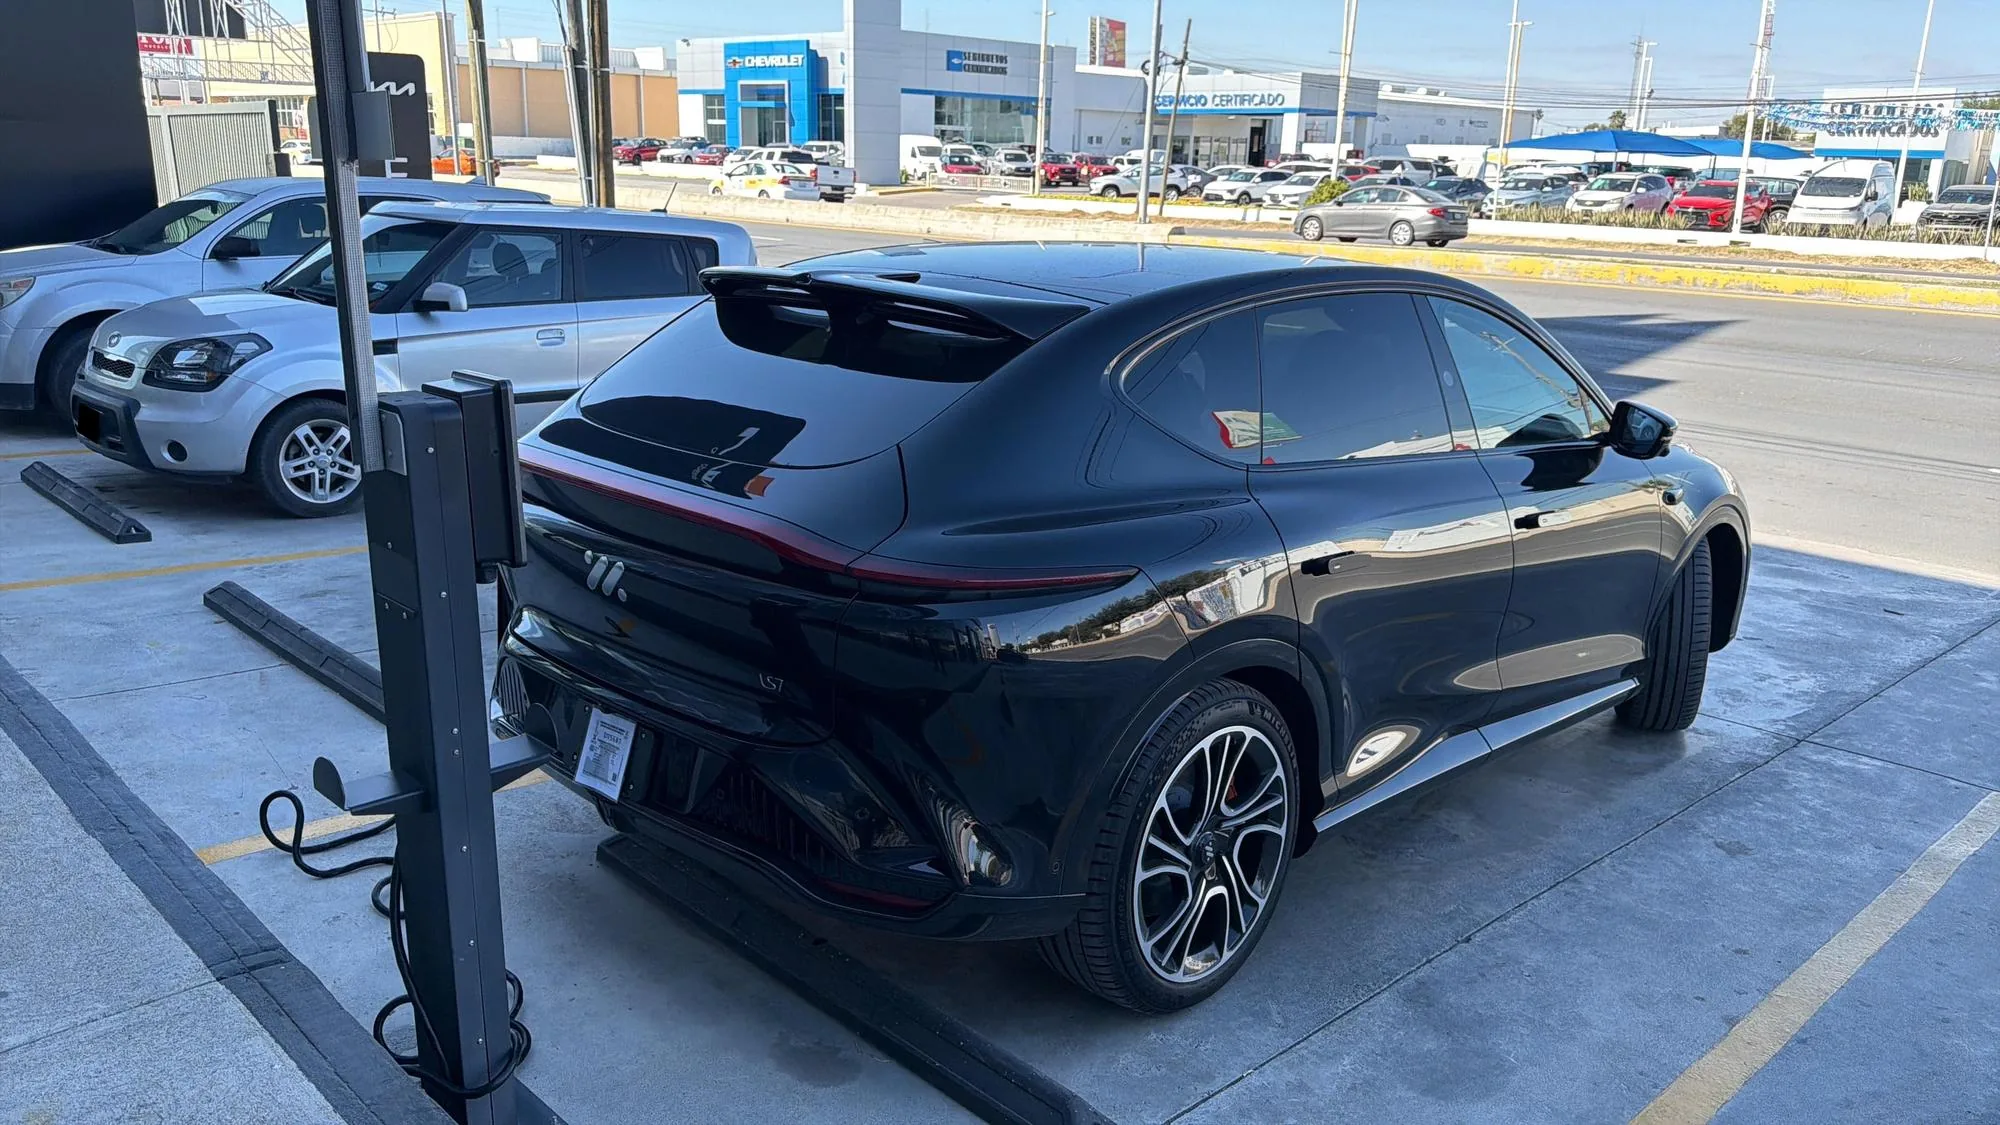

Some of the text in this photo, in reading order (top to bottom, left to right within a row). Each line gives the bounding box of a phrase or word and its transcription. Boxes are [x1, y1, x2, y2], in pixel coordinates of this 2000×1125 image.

[745, 54, 806, 68] CHEVROLET
[1212, 93, 1285, 107] CERTIFICADO
[759, 673, 784, 692] LS7
